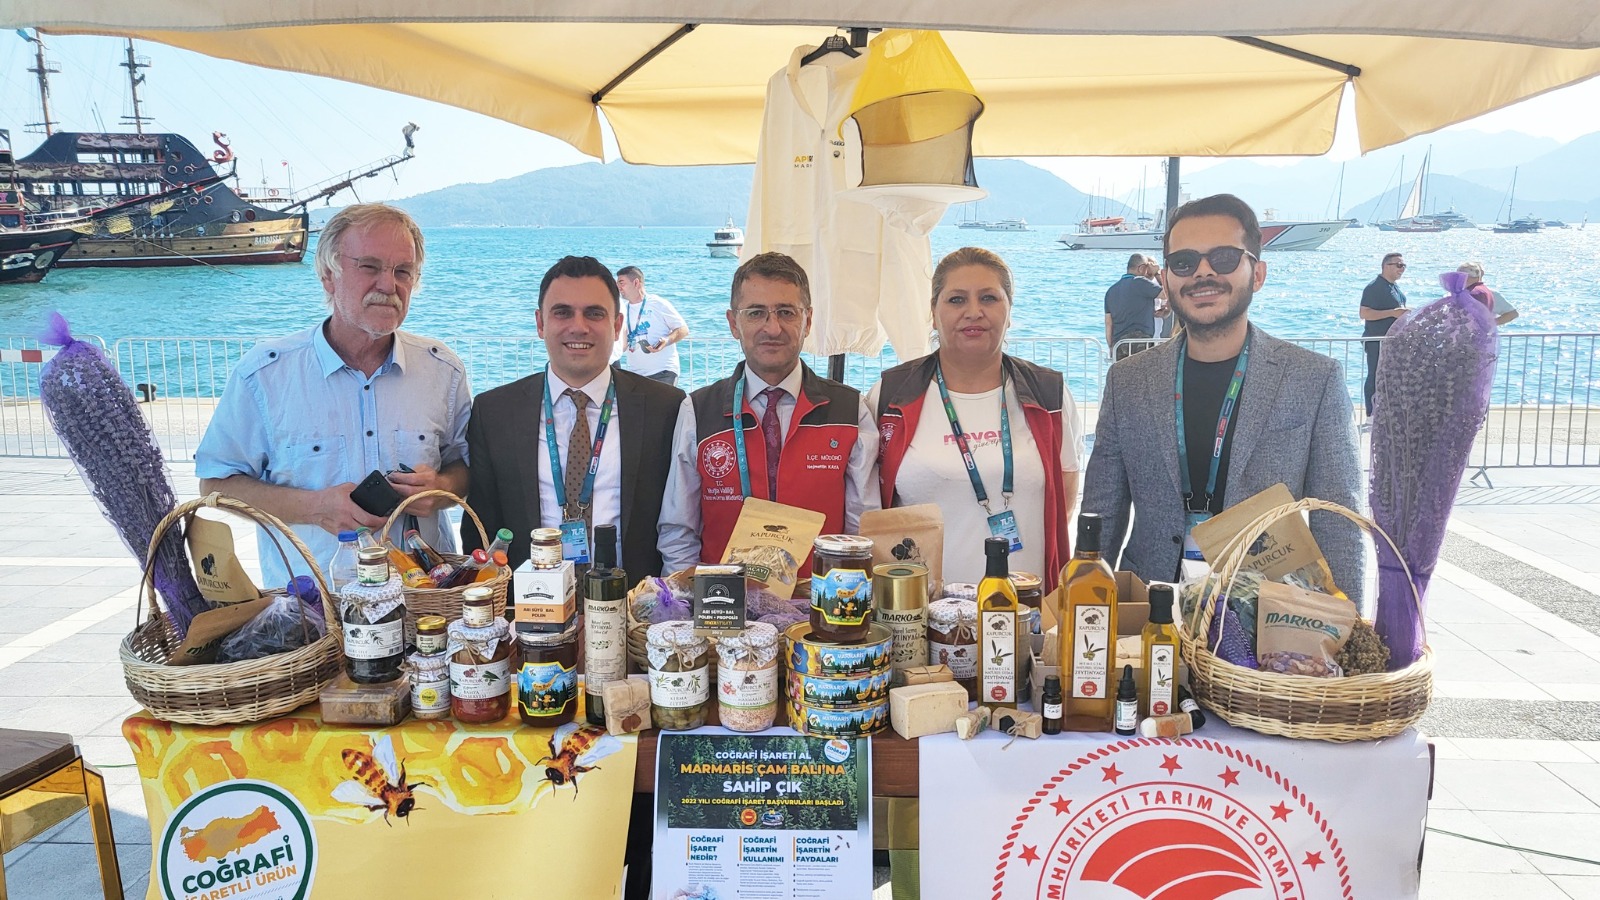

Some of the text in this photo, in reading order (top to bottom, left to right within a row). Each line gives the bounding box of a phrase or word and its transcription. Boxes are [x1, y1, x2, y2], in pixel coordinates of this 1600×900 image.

[750, 531, 794, 544] KAPURCUK
[1248, 543, 1295, 571] APURCUK
[881, 613, 913, 622] MARKO
[1265, 612, 1323, 629] MARKO
[715, 749, 812, 761] COĞRAFİ İŞARETİ AL
[680, 761, 754, 775] MARMARİS
[756, 764, 787, 777] ÇAM
[722, 778, 802, 796] SAHİP ÇIK
[711, 797, 741, 806] COĞRAFİ
[742, 798, 766, 806] İŞARET
[690, 834, 724, 843] COĞRAFİ
[743, 835, 777, 844] COĞRAFİ
[796, 836, 829, 845] COĞRAFİ
[690, 844, 716, 854] İŞARET
[742, 845, 778, 854] İŞARETİN
[796, 846, 831, 855] İŞARETİN
[1047, 791, 1298, 900] MHURİYETİ TARIM VE ORMA
[690, 853, 718, 861] NEDİR?
[183, 835, 295, 894] COĞRAFİ
[255, 864, 297, 887] ÜRÜN
